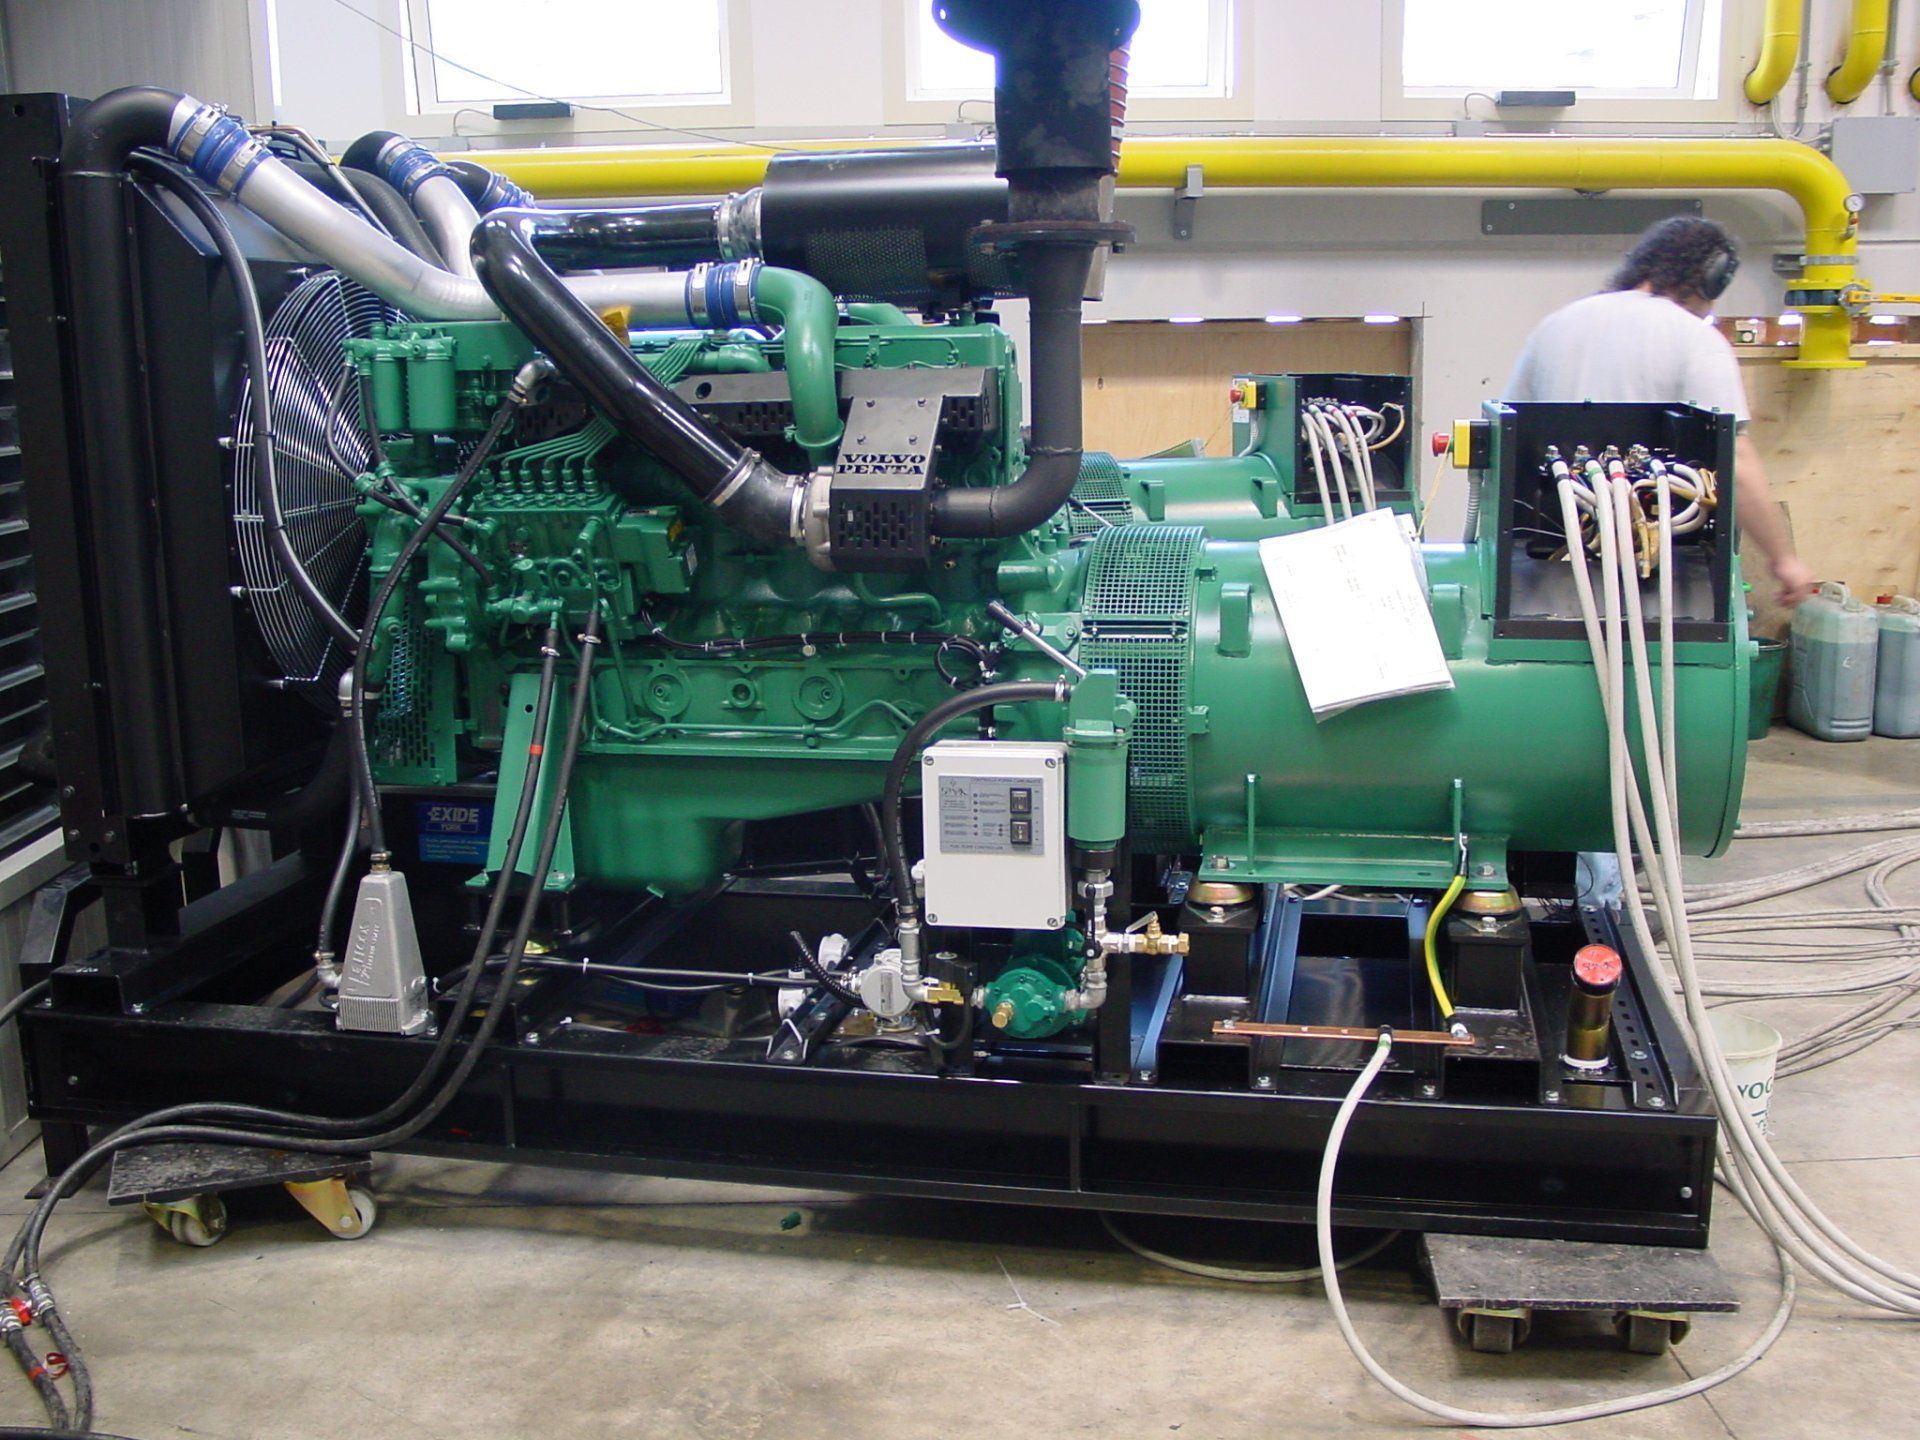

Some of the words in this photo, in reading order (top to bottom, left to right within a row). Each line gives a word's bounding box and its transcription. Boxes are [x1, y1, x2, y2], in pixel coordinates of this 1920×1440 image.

[842, 453, 926, 464] VOLVO
[837, 464, 924, 475] PENTA
[427, 806, 480, 822] EXIDE
